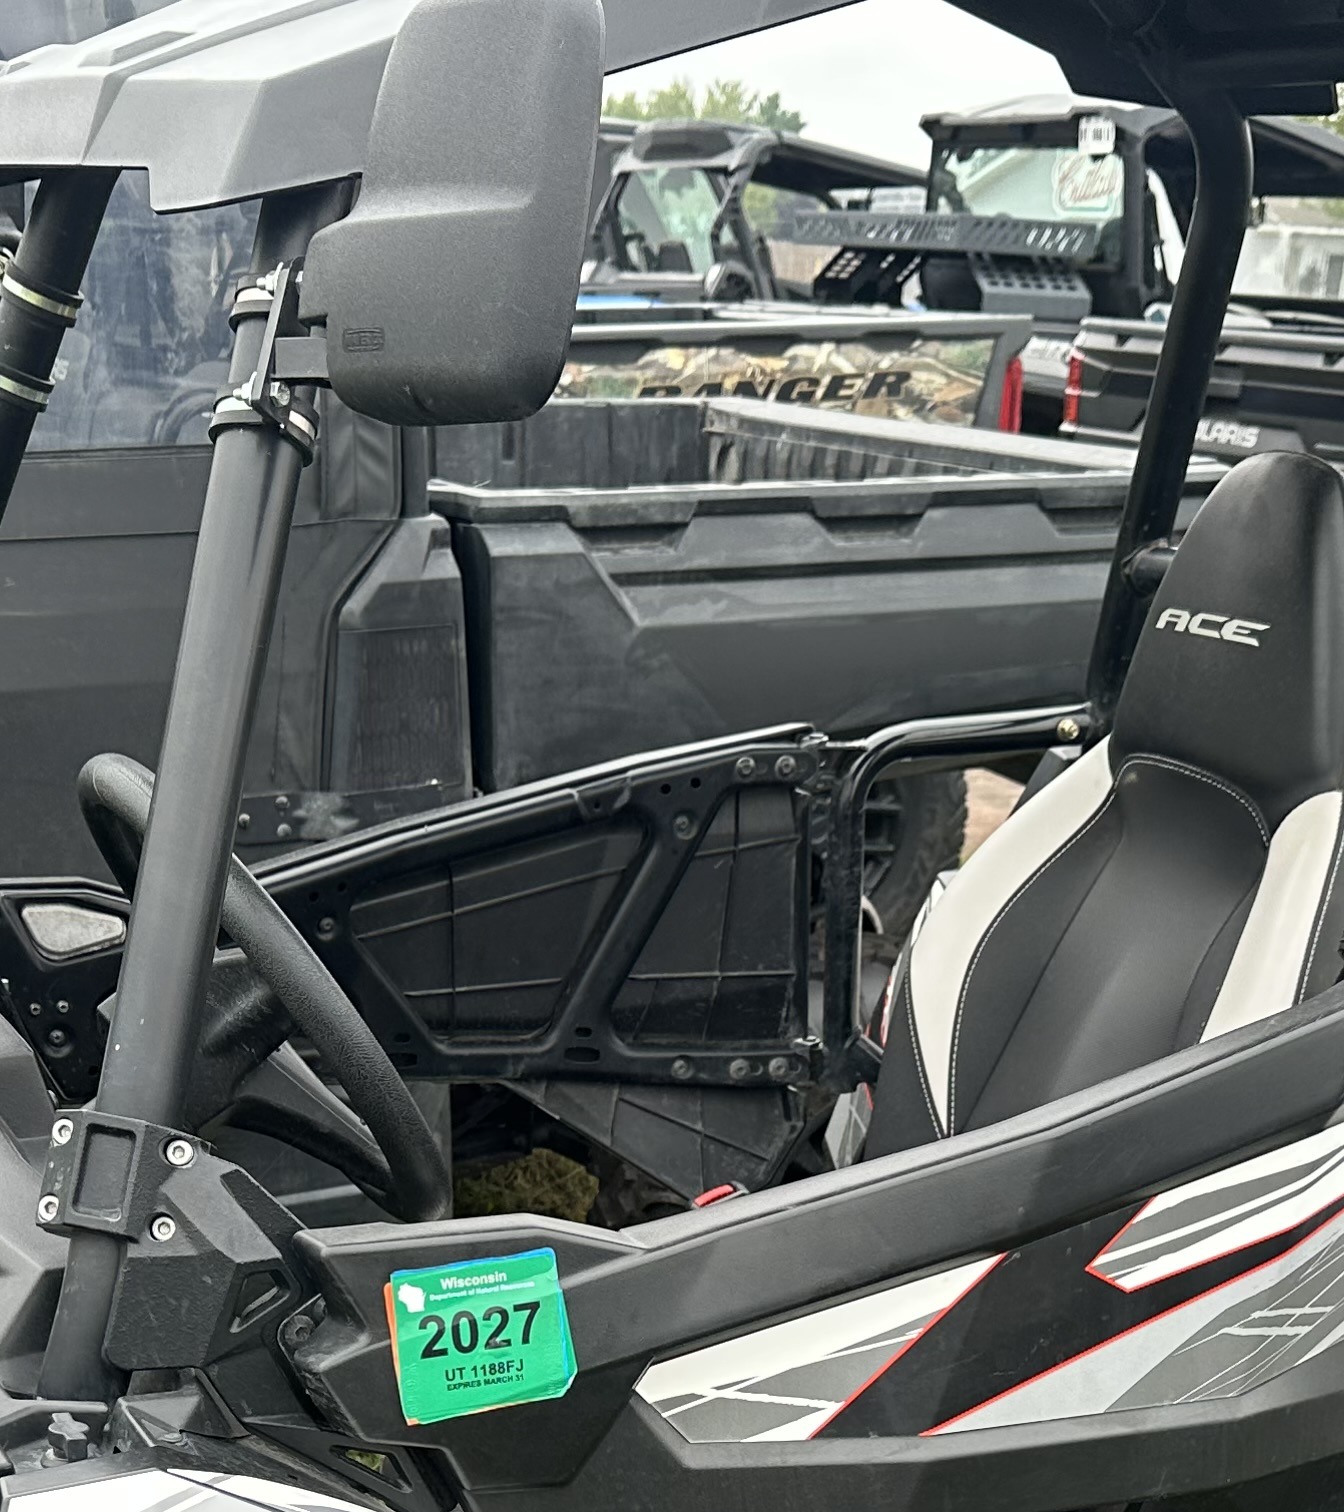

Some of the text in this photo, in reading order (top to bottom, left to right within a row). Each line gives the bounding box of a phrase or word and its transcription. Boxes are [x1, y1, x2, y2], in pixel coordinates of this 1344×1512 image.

[1155, 608, 1271, 647] ACE
[440, 1271, 507, 1290] Wisconsin
[418, 1301, 541, 1360] 2027
[445, 1358, 524, 1382] UT 1188FJ
[446, 1380, 482, 1391] EXPIRES
[484, 1376, 513, 1386] MARCH
